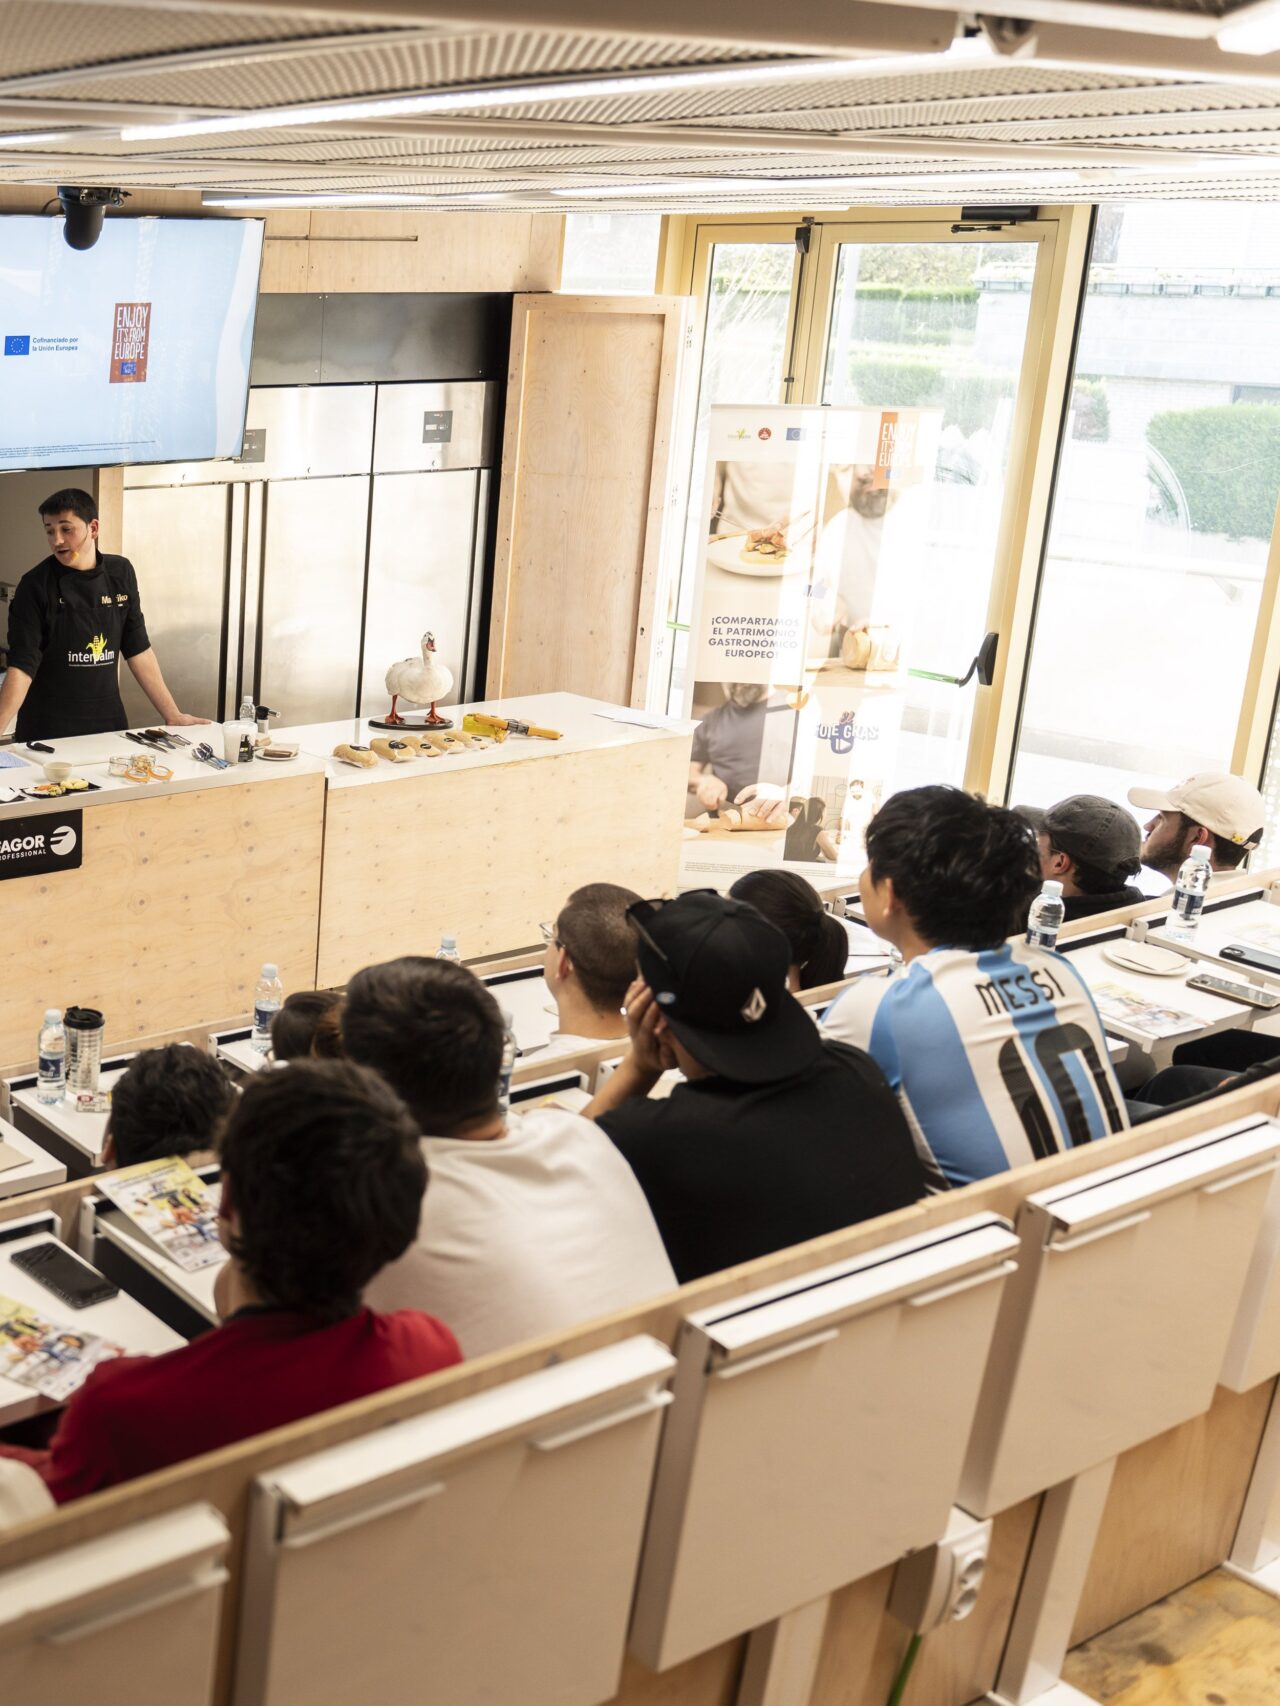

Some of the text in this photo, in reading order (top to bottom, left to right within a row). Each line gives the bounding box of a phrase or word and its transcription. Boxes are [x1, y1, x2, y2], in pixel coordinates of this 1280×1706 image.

[116, 306, 149, 328] ENJOY
[116, 327, 146, 343] IT'S FROM
[114, 343, 145, 359] EUROPE
[713, 627, 796, 637] EL PATRIMONIO
[708, 638, 798, 648] GASTRONÓMICO
[975, 967, 1066, 1016] MESSI
[998, 1022, 1124, 1161] 10
